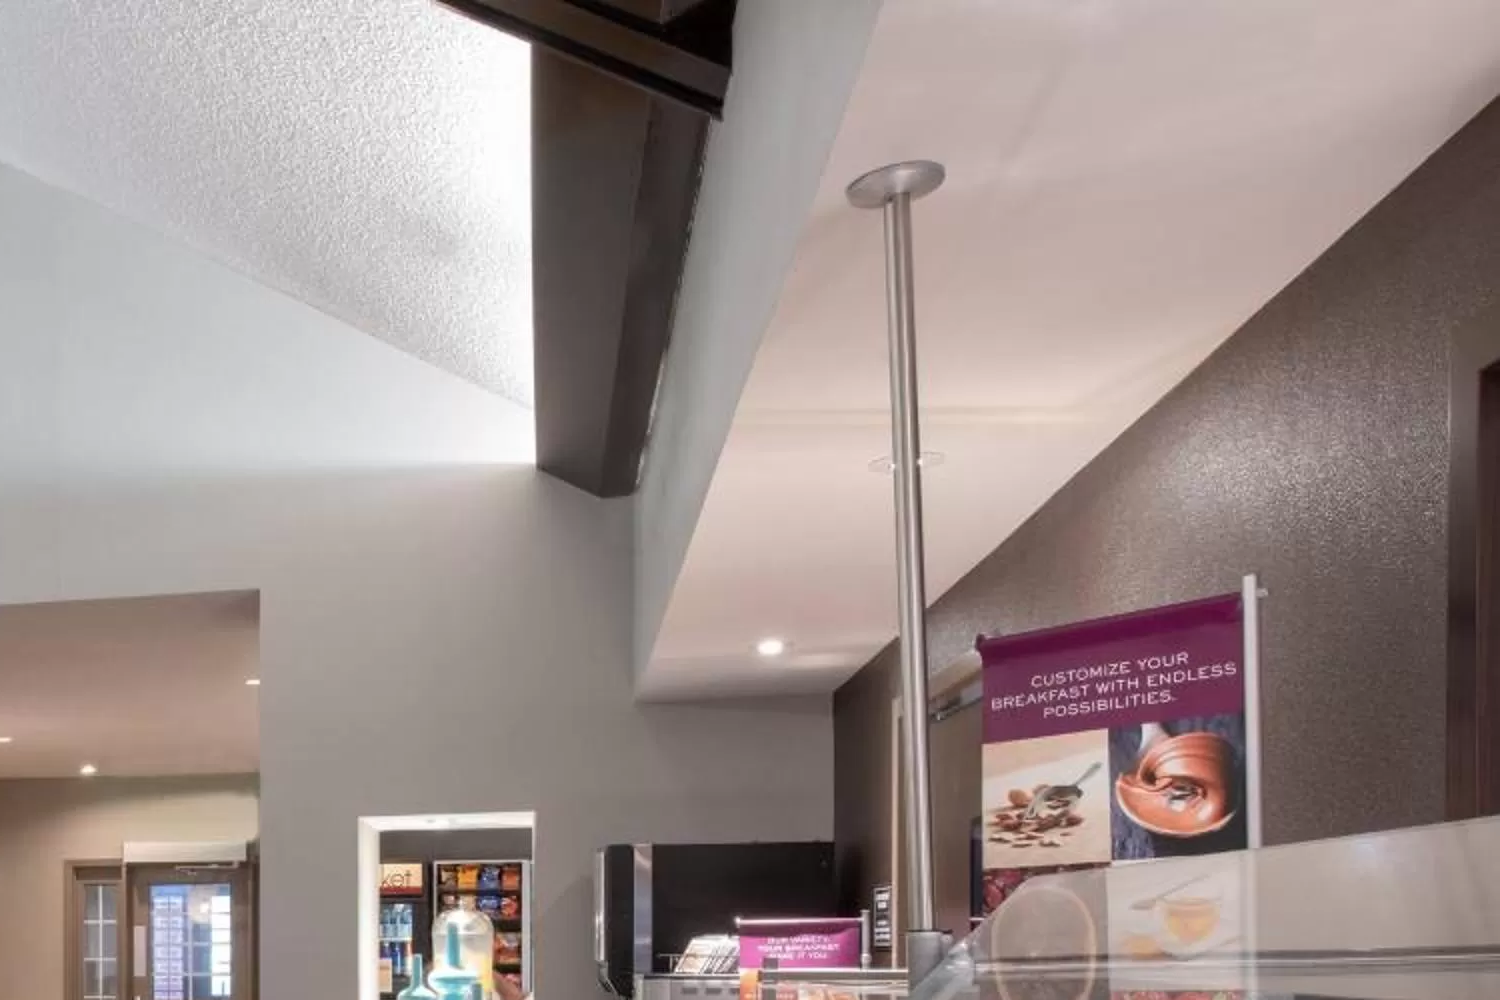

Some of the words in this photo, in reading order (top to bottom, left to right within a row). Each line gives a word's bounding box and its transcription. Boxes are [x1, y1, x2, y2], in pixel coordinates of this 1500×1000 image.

[991, 683, 1090, 711] BREAKFAST
[1095, 677, 1139, 695] WITH
[1147, 662, 1237, 688] ENDLESS
[1031, 662, 1131, 688] CUSTOMIZE
[1137, 651, 1189, 671] YOUR
[1043, 689, 1178, 718] POSSIBILITIES.
